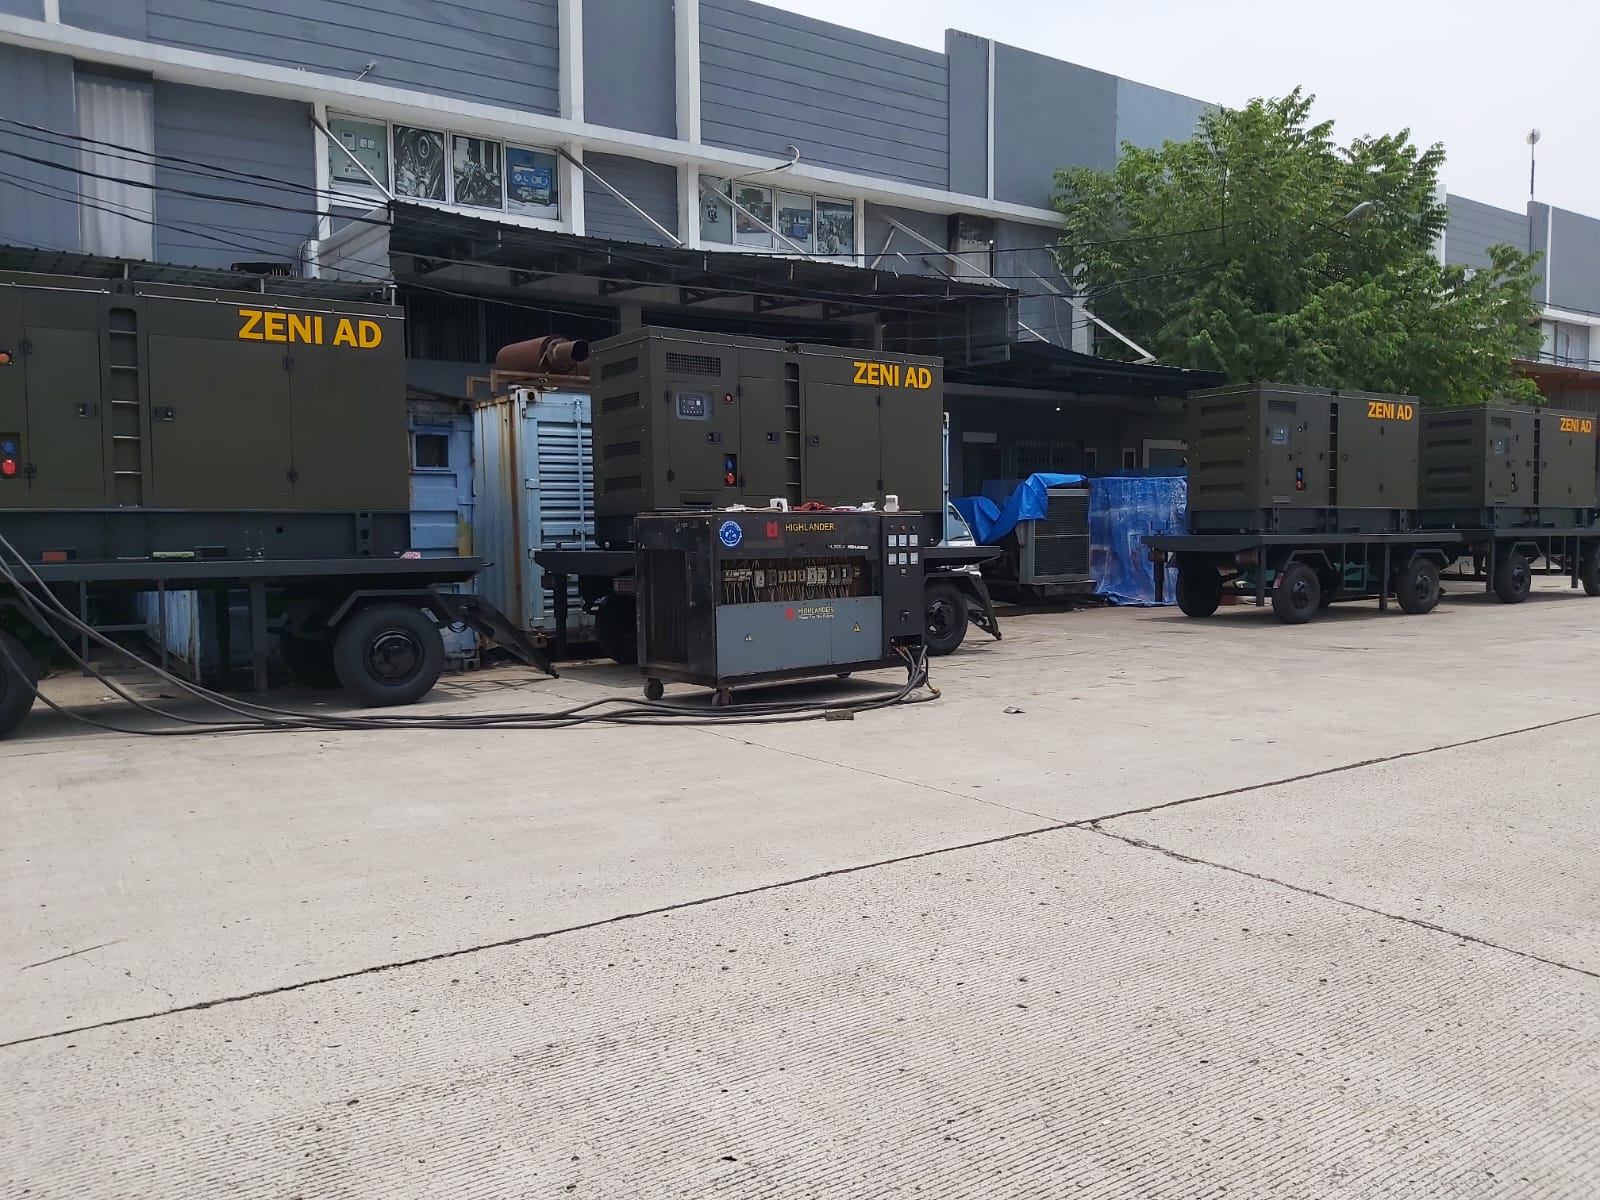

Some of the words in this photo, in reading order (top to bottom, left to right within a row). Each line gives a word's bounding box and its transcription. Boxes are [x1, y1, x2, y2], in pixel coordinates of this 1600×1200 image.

[238, 309, 323, 345] ZENI
[333, 318, 382, 349] AD
[853, 361, 899, 387] ZENI
[904, 366, 932, 389] AD
[1368, 401, 1395, 419] ZENI
[1396, 404, 1413, 420] AD
[1560, 417, 1579, 432] ZENI
[1580, 419, 1592, 433] AD
[785, 522, 835, 532] HIGHLANDER
